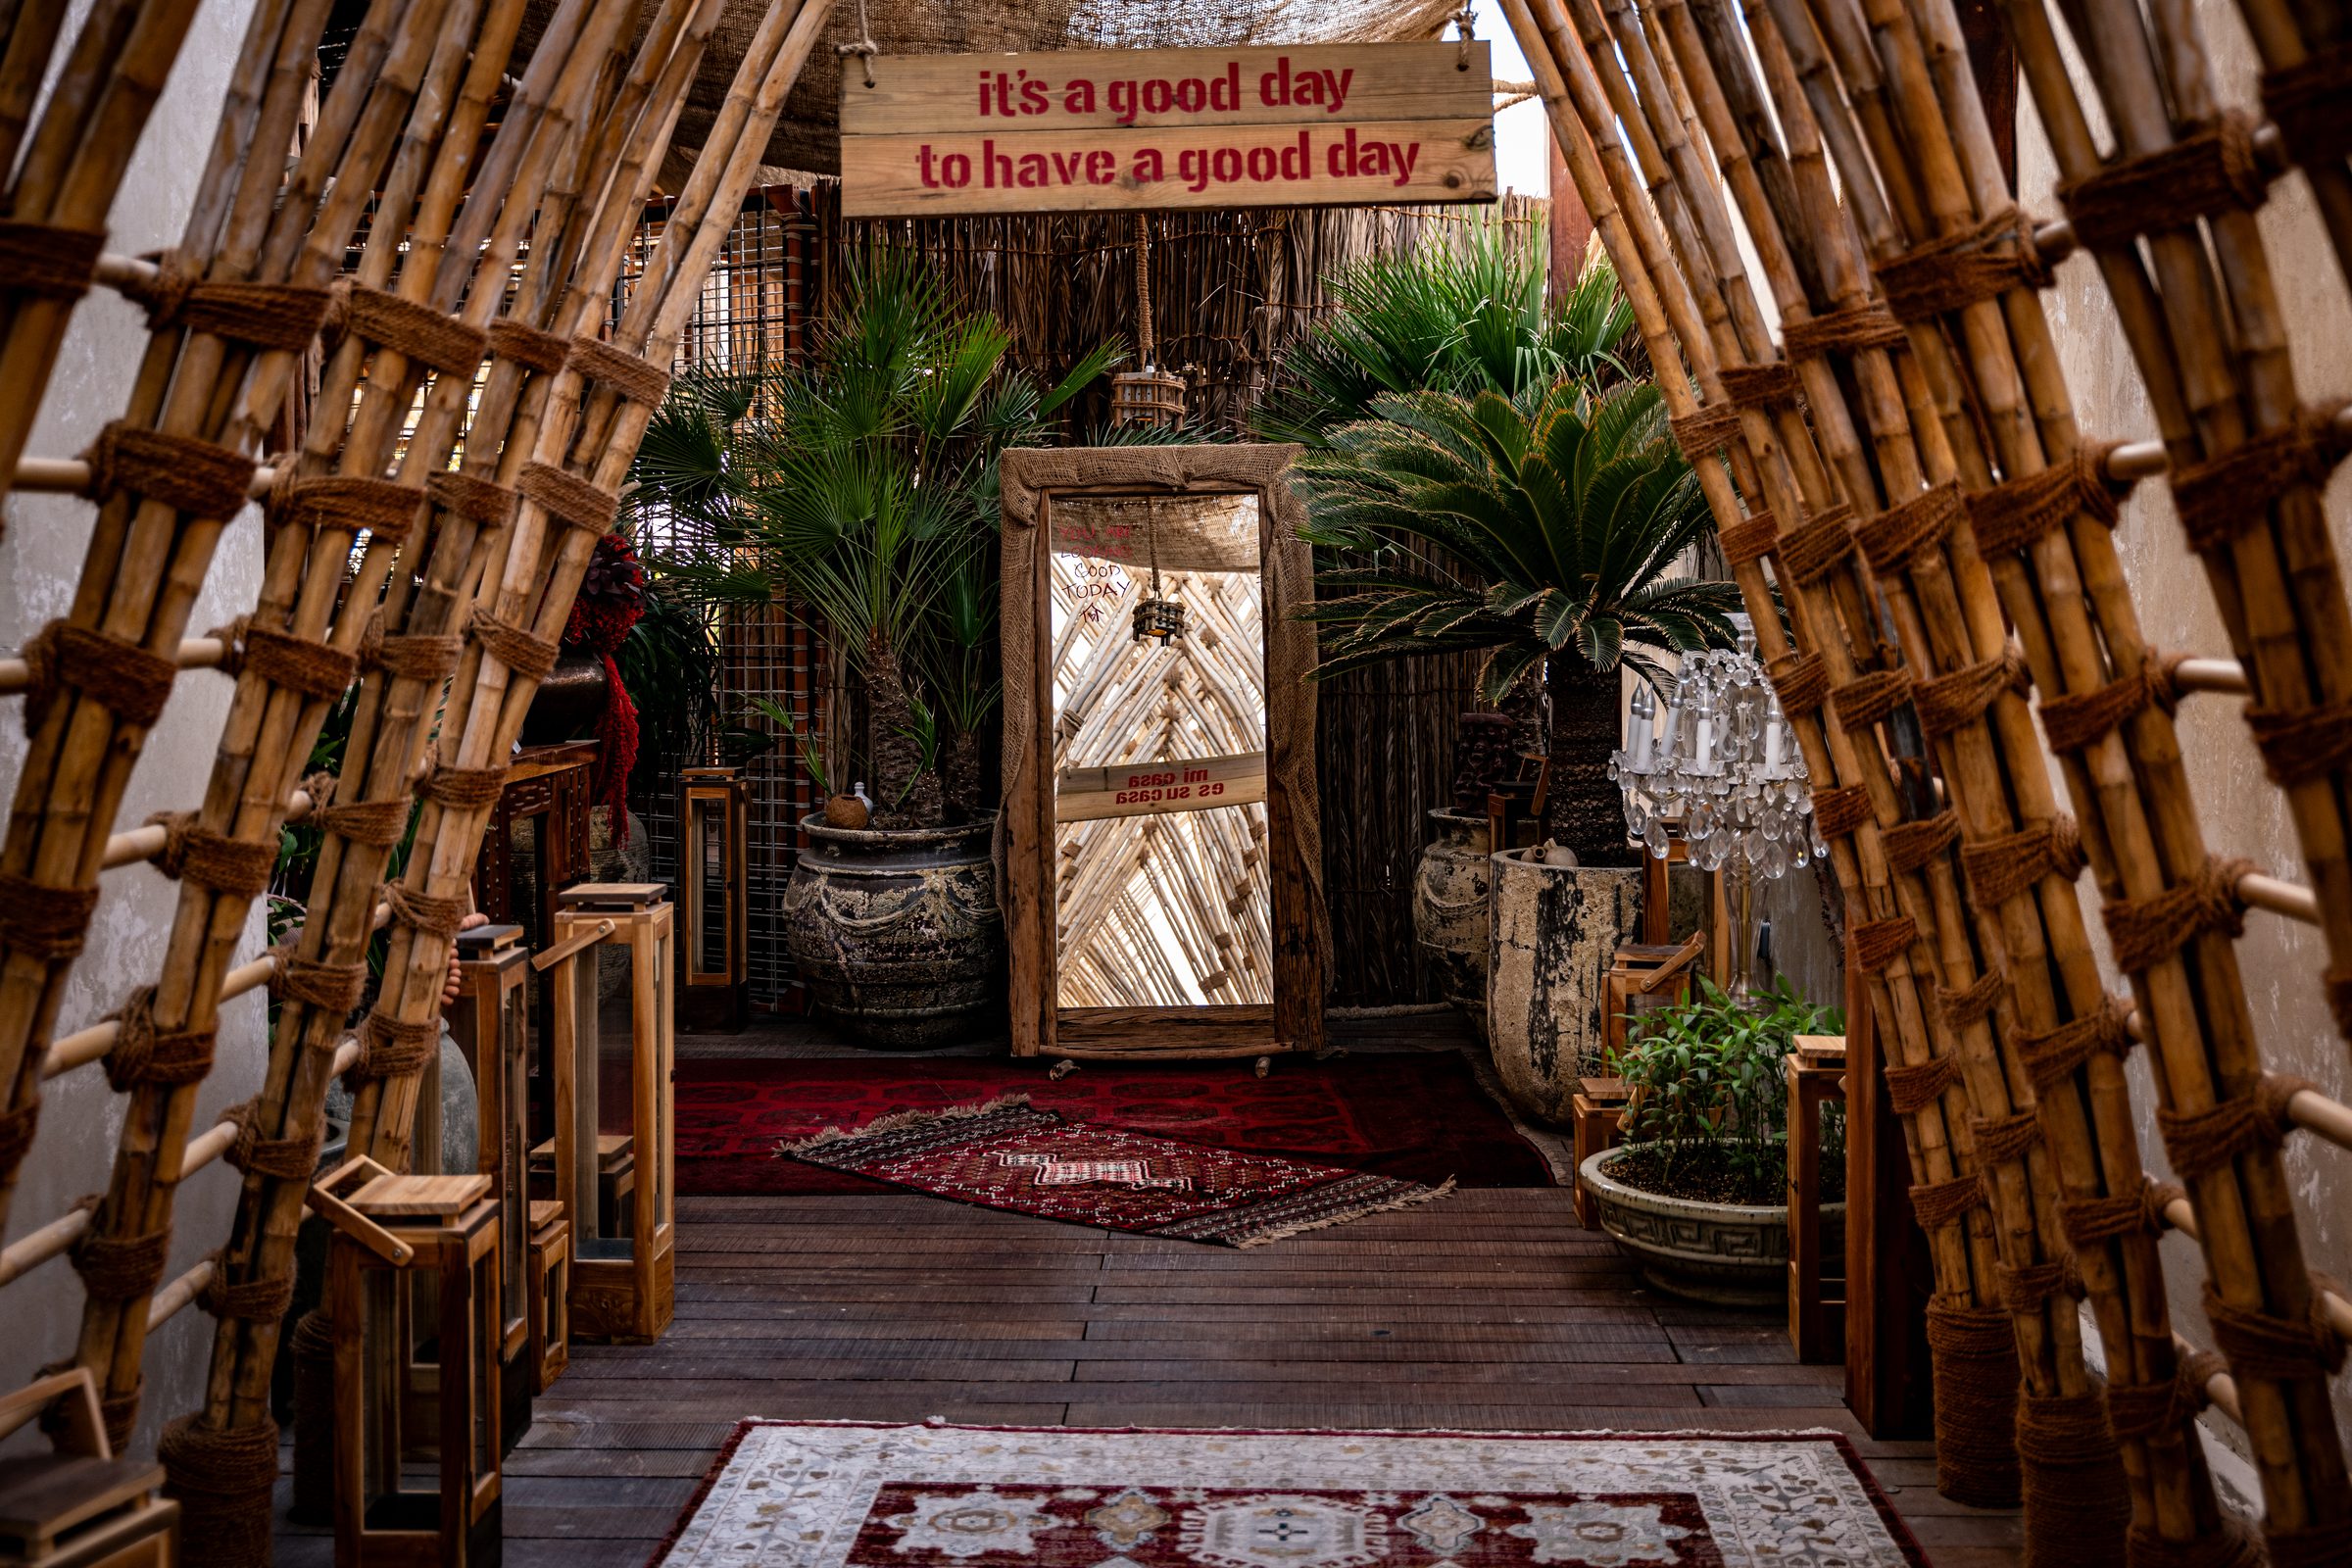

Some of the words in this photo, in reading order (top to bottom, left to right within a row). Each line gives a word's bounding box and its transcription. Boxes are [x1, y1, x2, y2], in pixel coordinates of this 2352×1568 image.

[1064, 77, 1096, 115] a
[1107, 62, 1241, 124] good
[1259, 57, 1354, 113] day
[915, 144, 971, 189] to
[983, 139, 1116, 189] have
[1132, 148, 1165, 182] a
[1179, 130, 1311, 193] good
[1328, 128, 1420, 187] day
[1059, 524, 1095, 540] YOU
[1061, 545, 1132, 559] LOOKING
[1074, 563, 1121, 578] GOOD
[1061, 581, 1131, 599] TODAY
